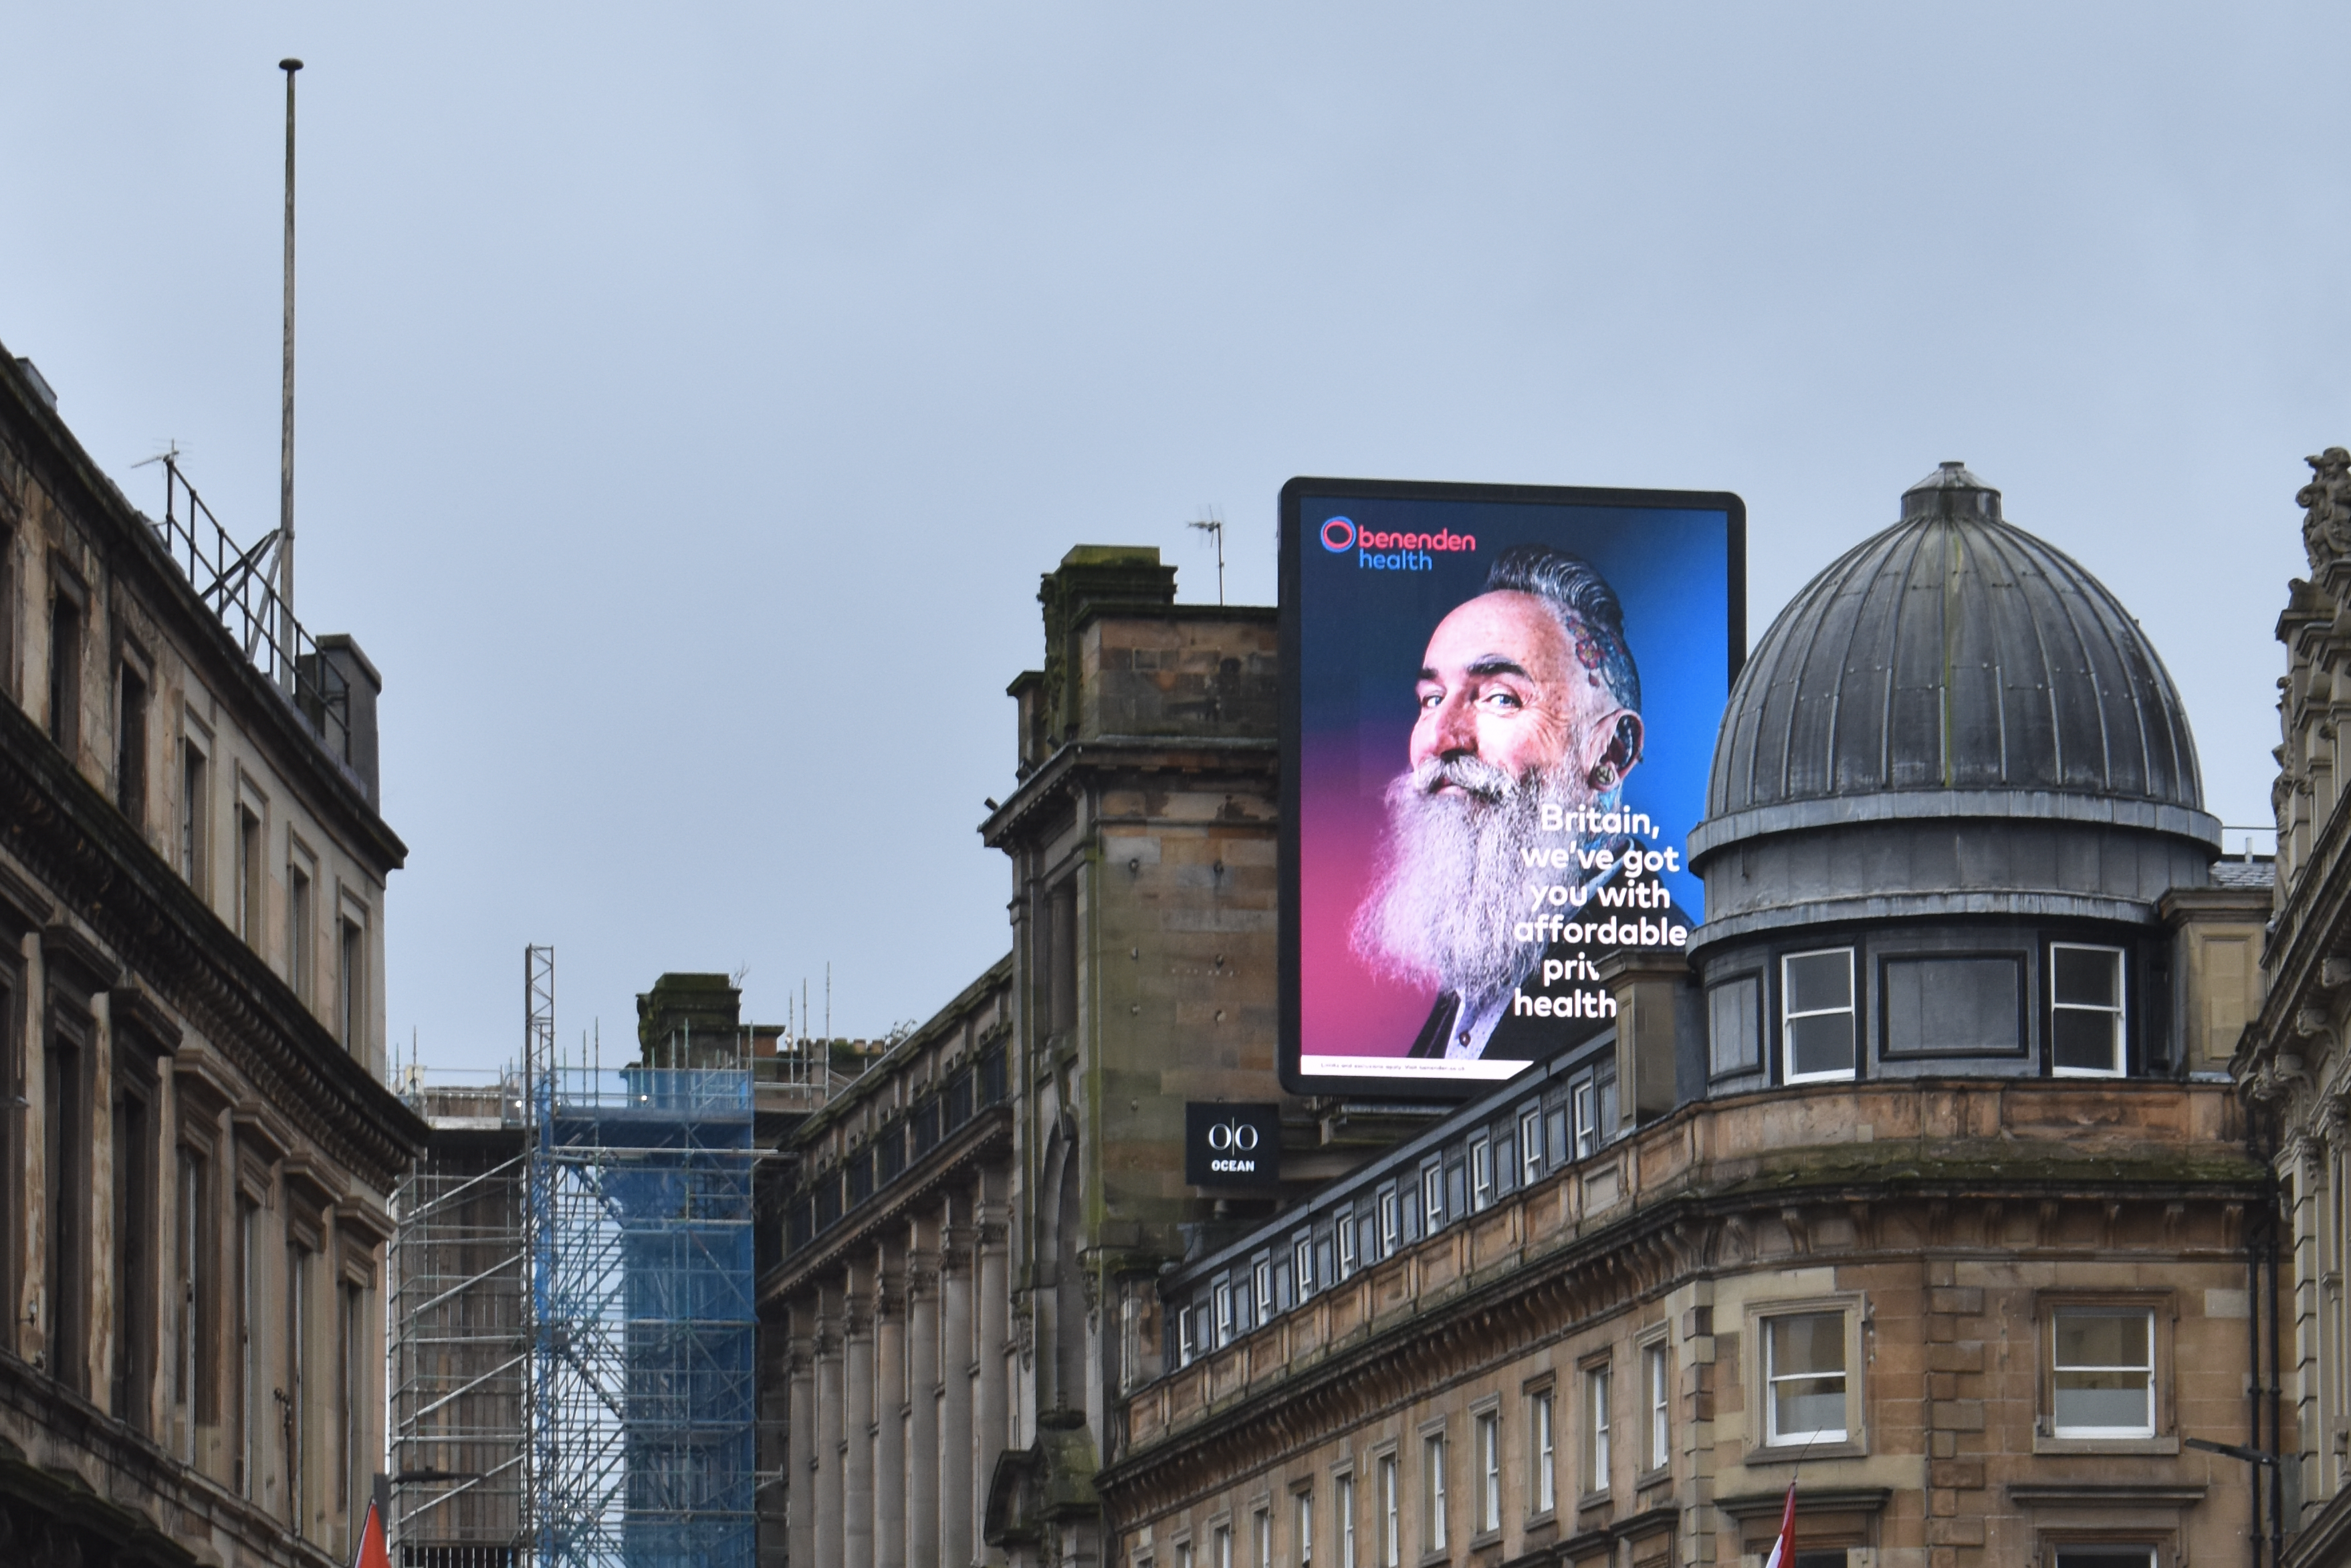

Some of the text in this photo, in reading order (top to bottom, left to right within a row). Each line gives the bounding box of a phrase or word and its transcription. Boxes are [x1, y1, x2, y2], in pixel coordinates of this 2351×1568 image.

[1359, 524, 1476, 551] benenden
[1359, 548, 1432, 571] health
[1541, 804, 1660, 840] Britain,
[1521, 841, 1680, 879] we've got
[1529, 879, 1671, 913] you with
[1514, 913, 1688, 947] affordable
[1514, 987, 1617, 1018] health
[1212, 1159, 1255, 1172] OCEAN
